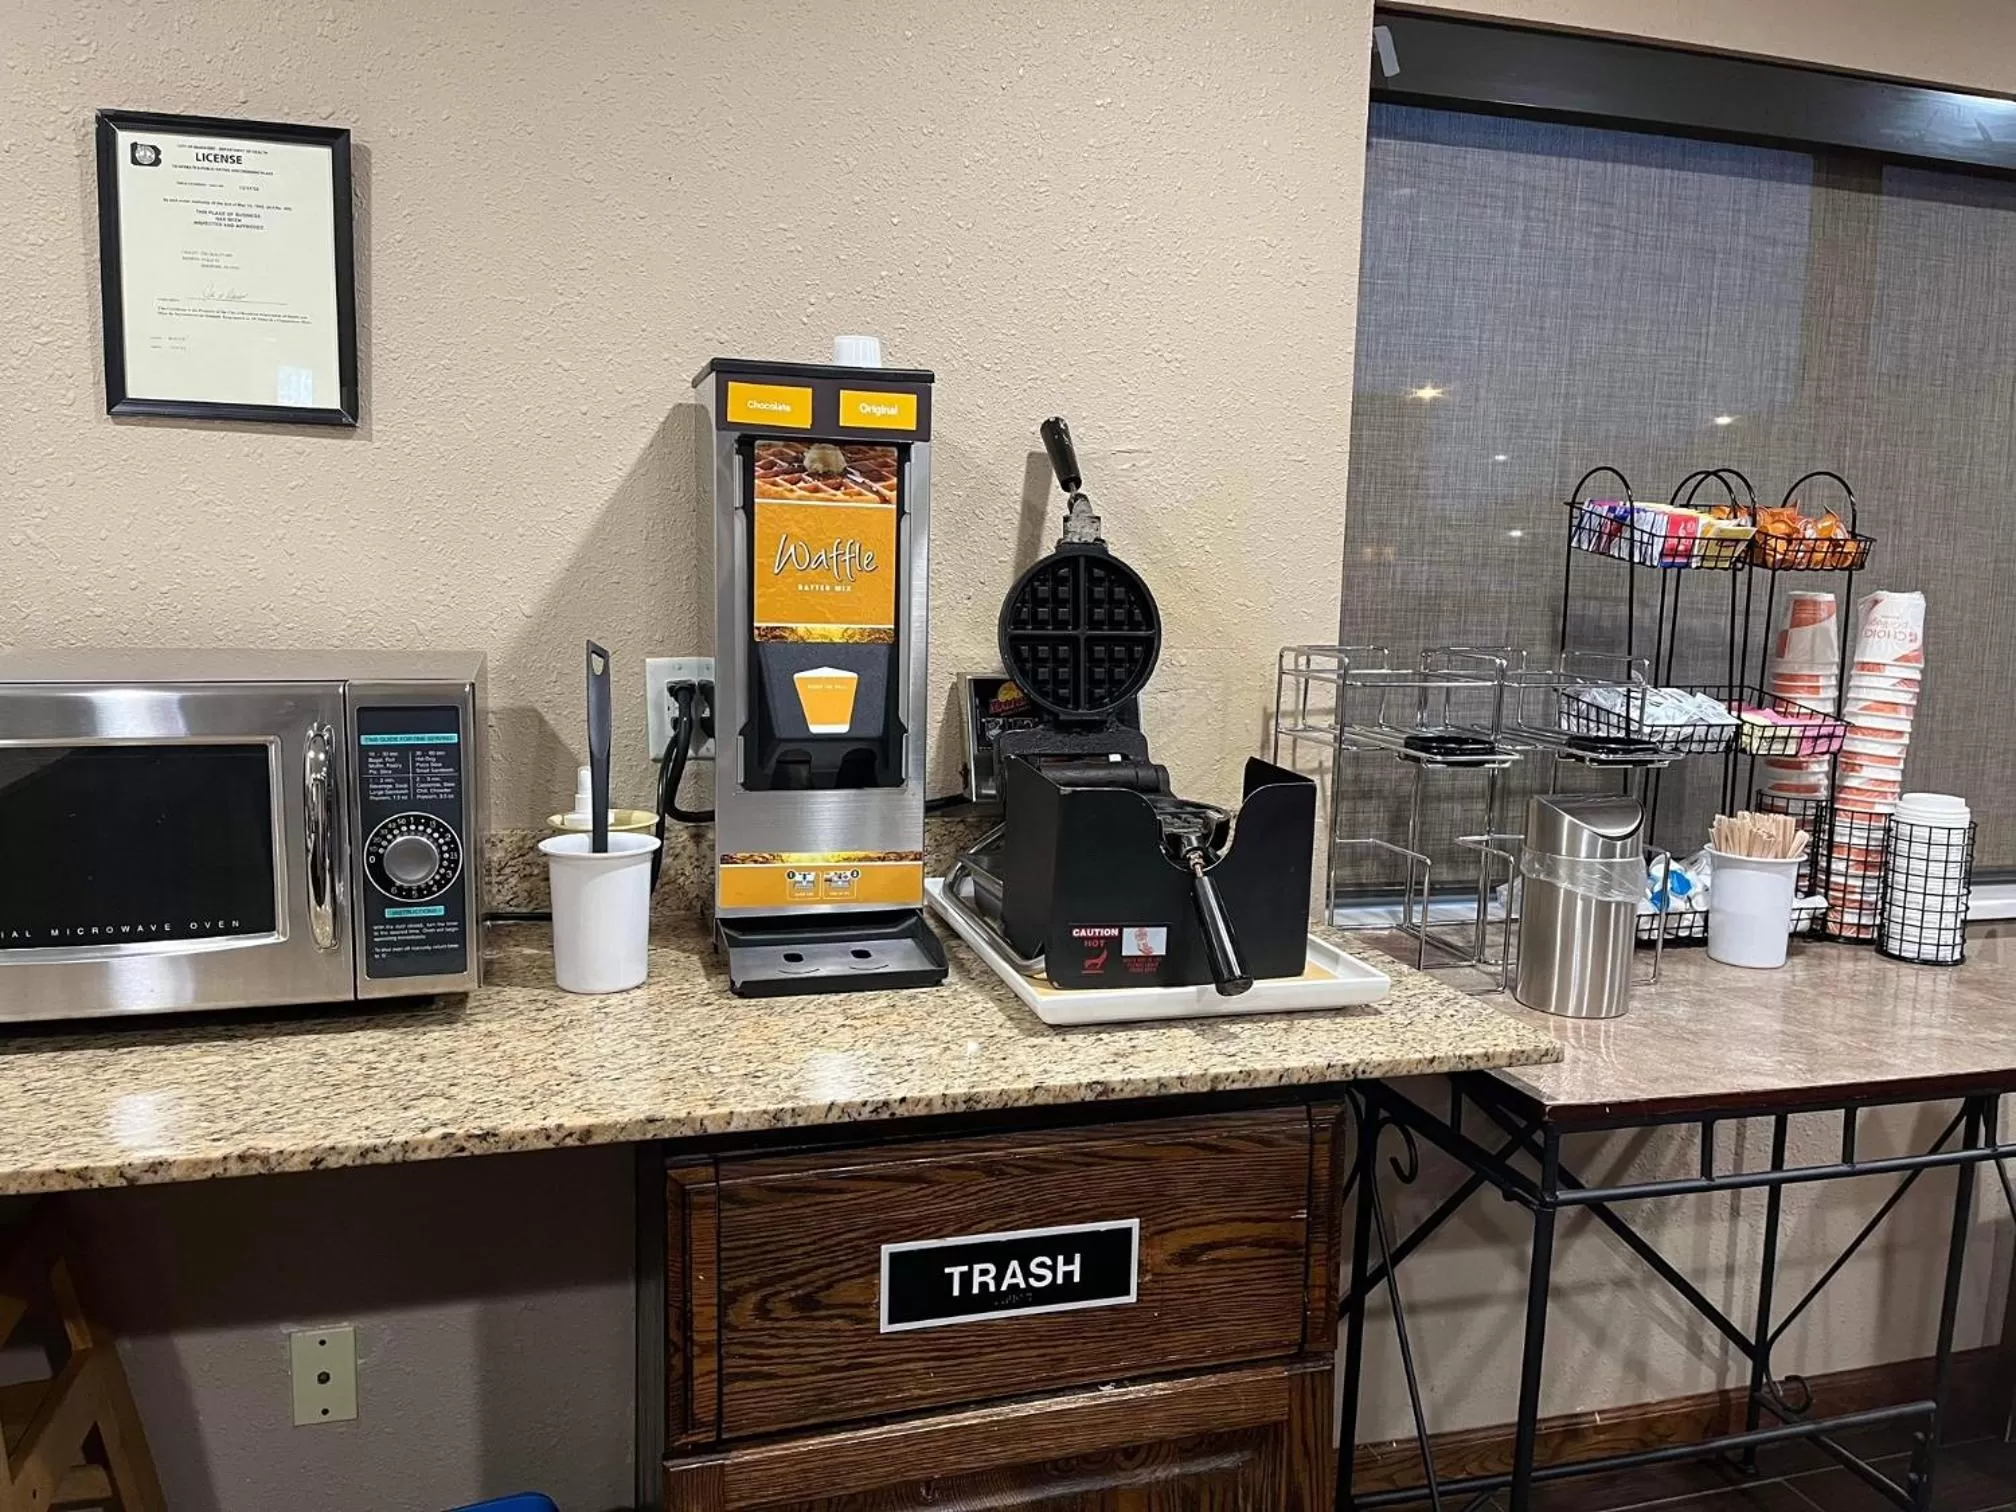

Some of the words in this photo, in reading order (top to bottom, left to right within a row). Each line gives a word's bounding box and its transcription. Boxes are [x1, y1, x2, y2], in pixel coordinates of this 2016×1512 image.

[195, 152, 243, 165] LICENSE
[747, 400, 792, 412] Chocolate
[859, 403, 899, 417] Original
[773, 534, 879, 583] Waffle
[50, 922, 171, 937] MICROWAVE
[189, 920, 240, 930] OVEN
[1072, 928, 1119, 937] CAUTION
[944, 1253, 1081, 1296] TRASH
